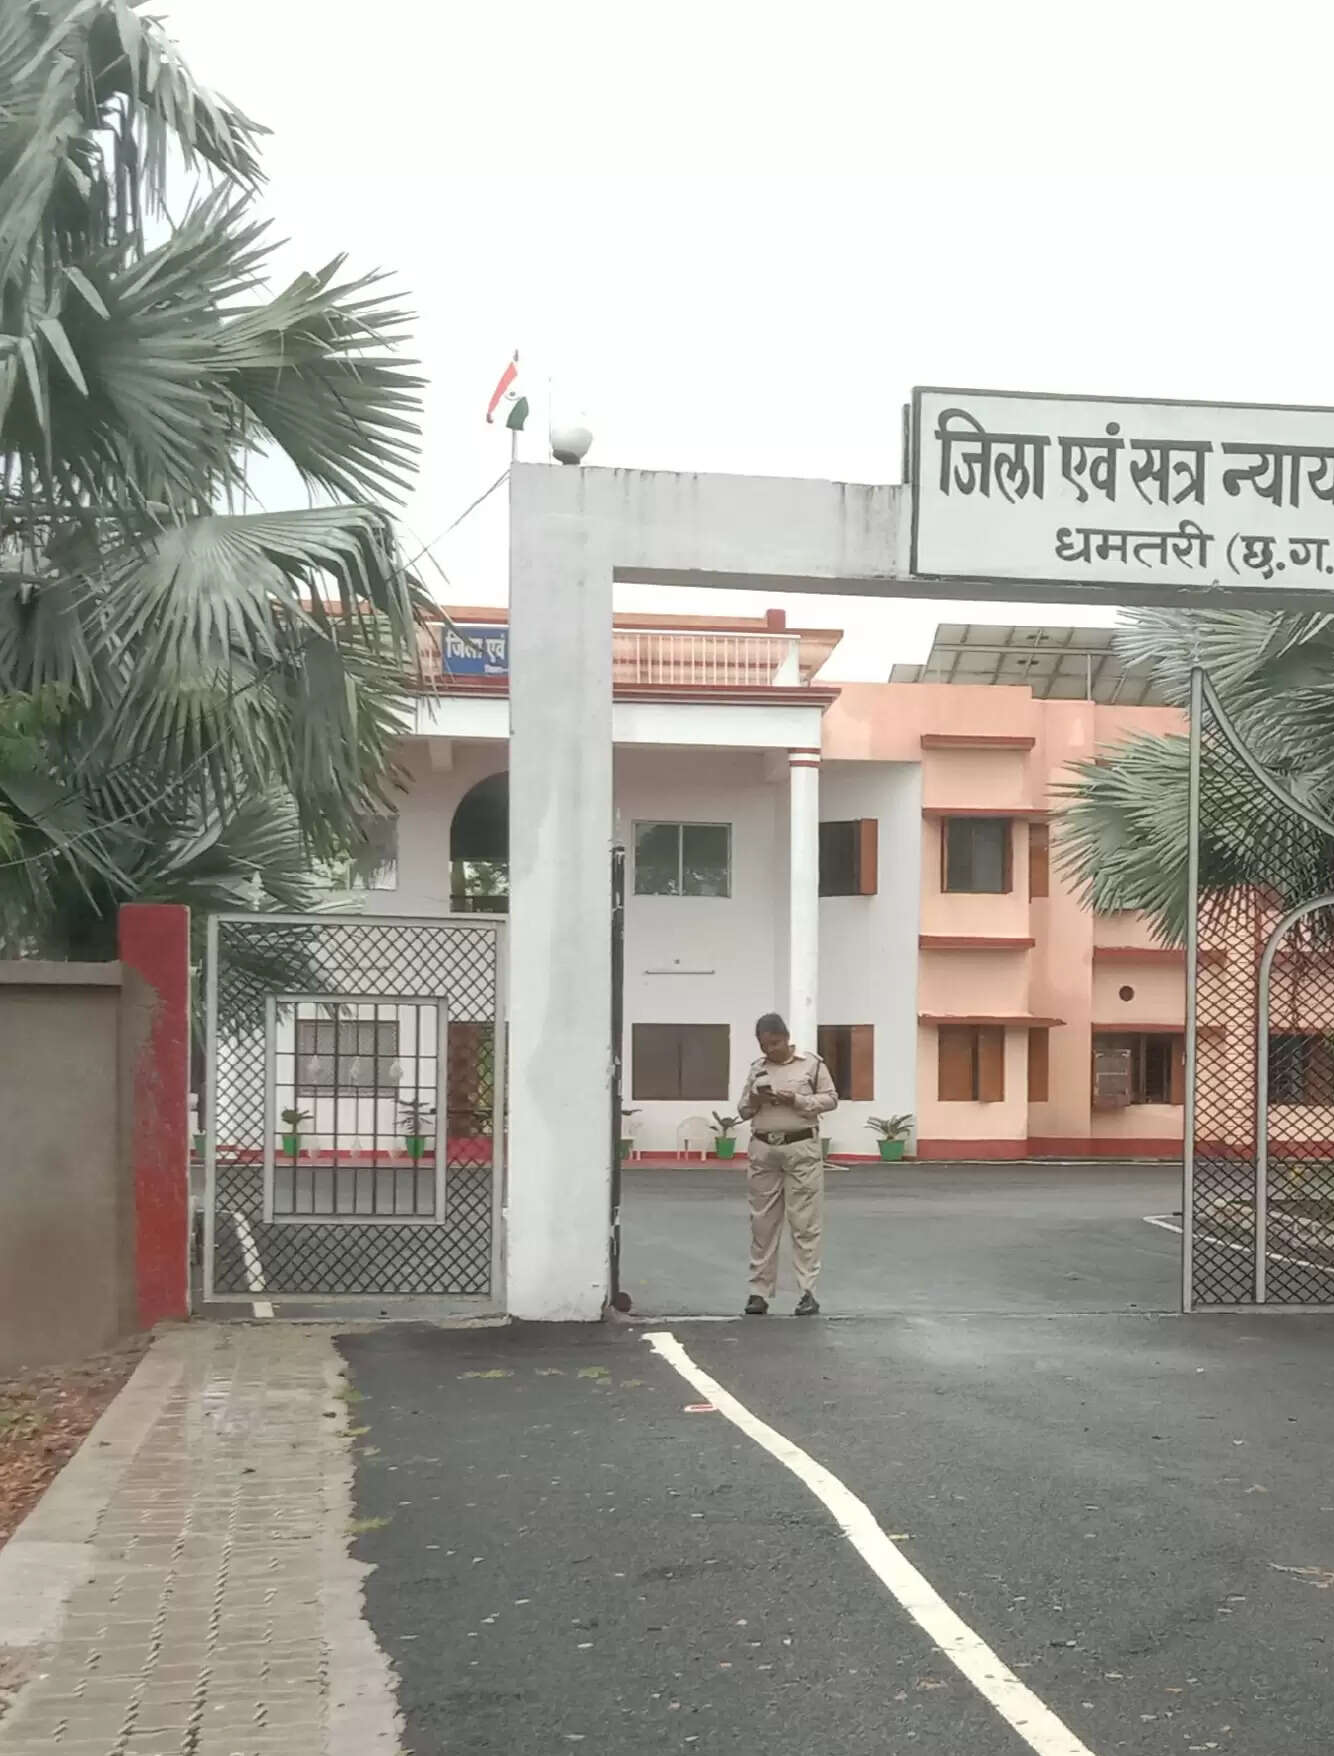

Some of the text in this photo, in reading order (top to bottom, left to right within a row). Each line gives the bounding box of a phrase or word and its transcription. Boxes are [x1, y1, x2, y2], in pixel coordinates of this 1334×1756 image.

[935, 408, 1051, 504] जिला
[1058, 422, 1125, 503] एवं
[1131, 439, 1214, 506] सत्र
[1056, 519, 1215, 569] धमतरी
